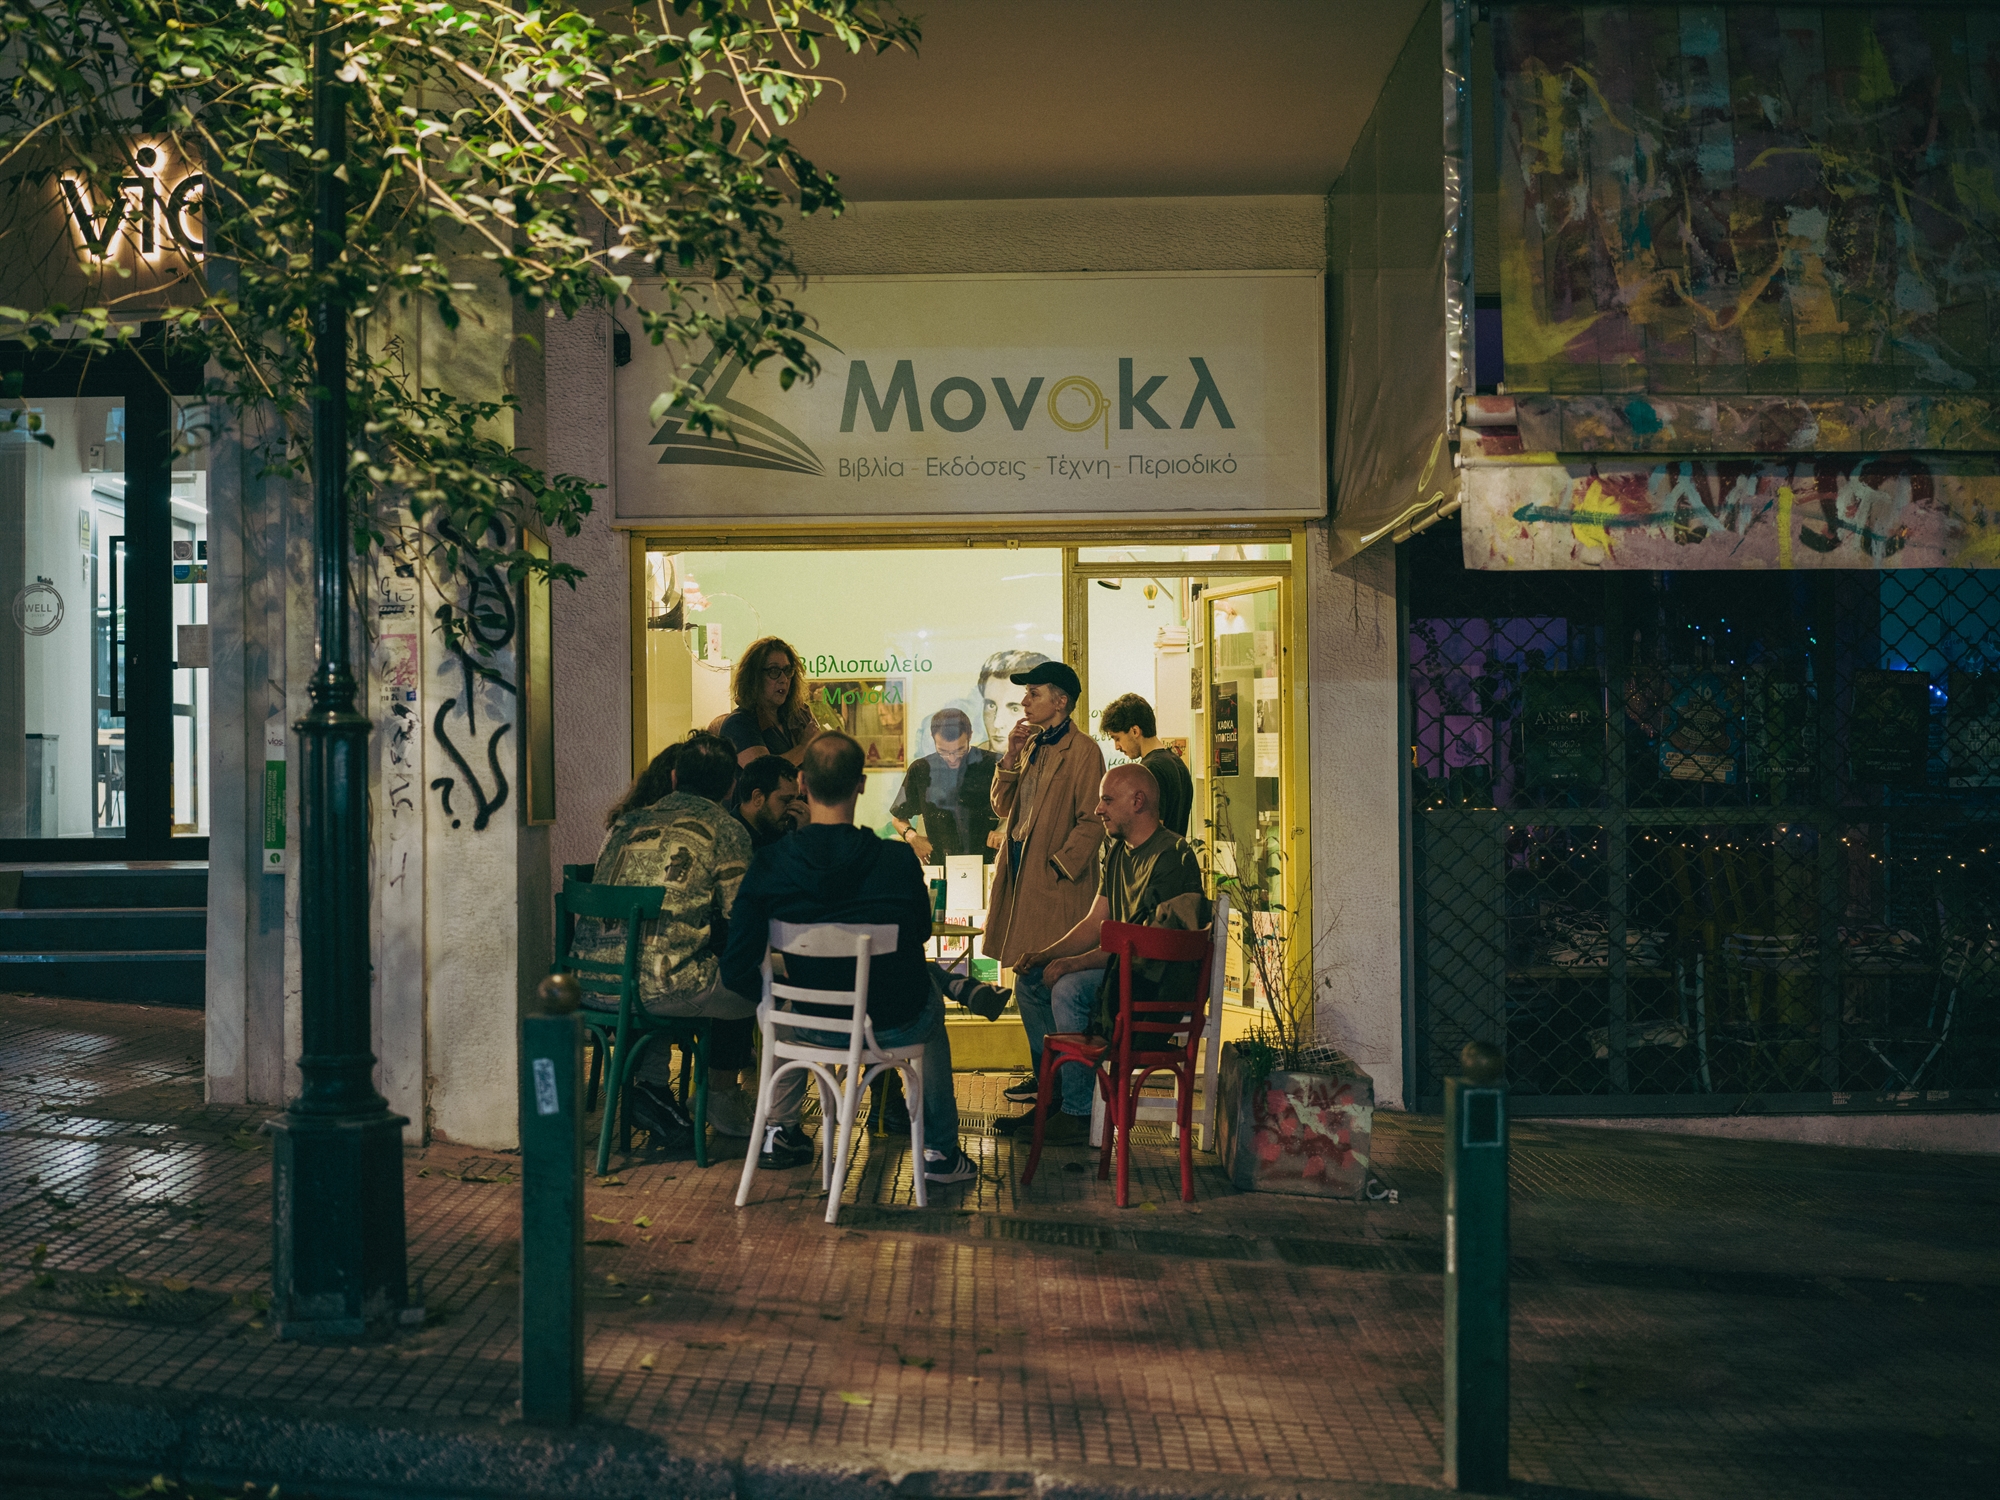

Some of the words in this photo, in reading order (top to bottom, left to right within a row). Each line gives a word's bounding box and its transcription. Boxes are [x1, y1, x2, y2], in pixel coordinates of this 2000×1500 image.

[839, 456, 904, 482] Βιβλία
[926, 455, 1026, 481] Εκδόσεις
[1046, 454, 1110, 480] Τέχνη
[1129, 453, 1237, 479] Περιοδικό
[24, 604, 52, 613] WELL
[822, 685, 904, 705] Μονόκλ
[1217, 720, 1234, 730] ΚΑΦΚΑ
